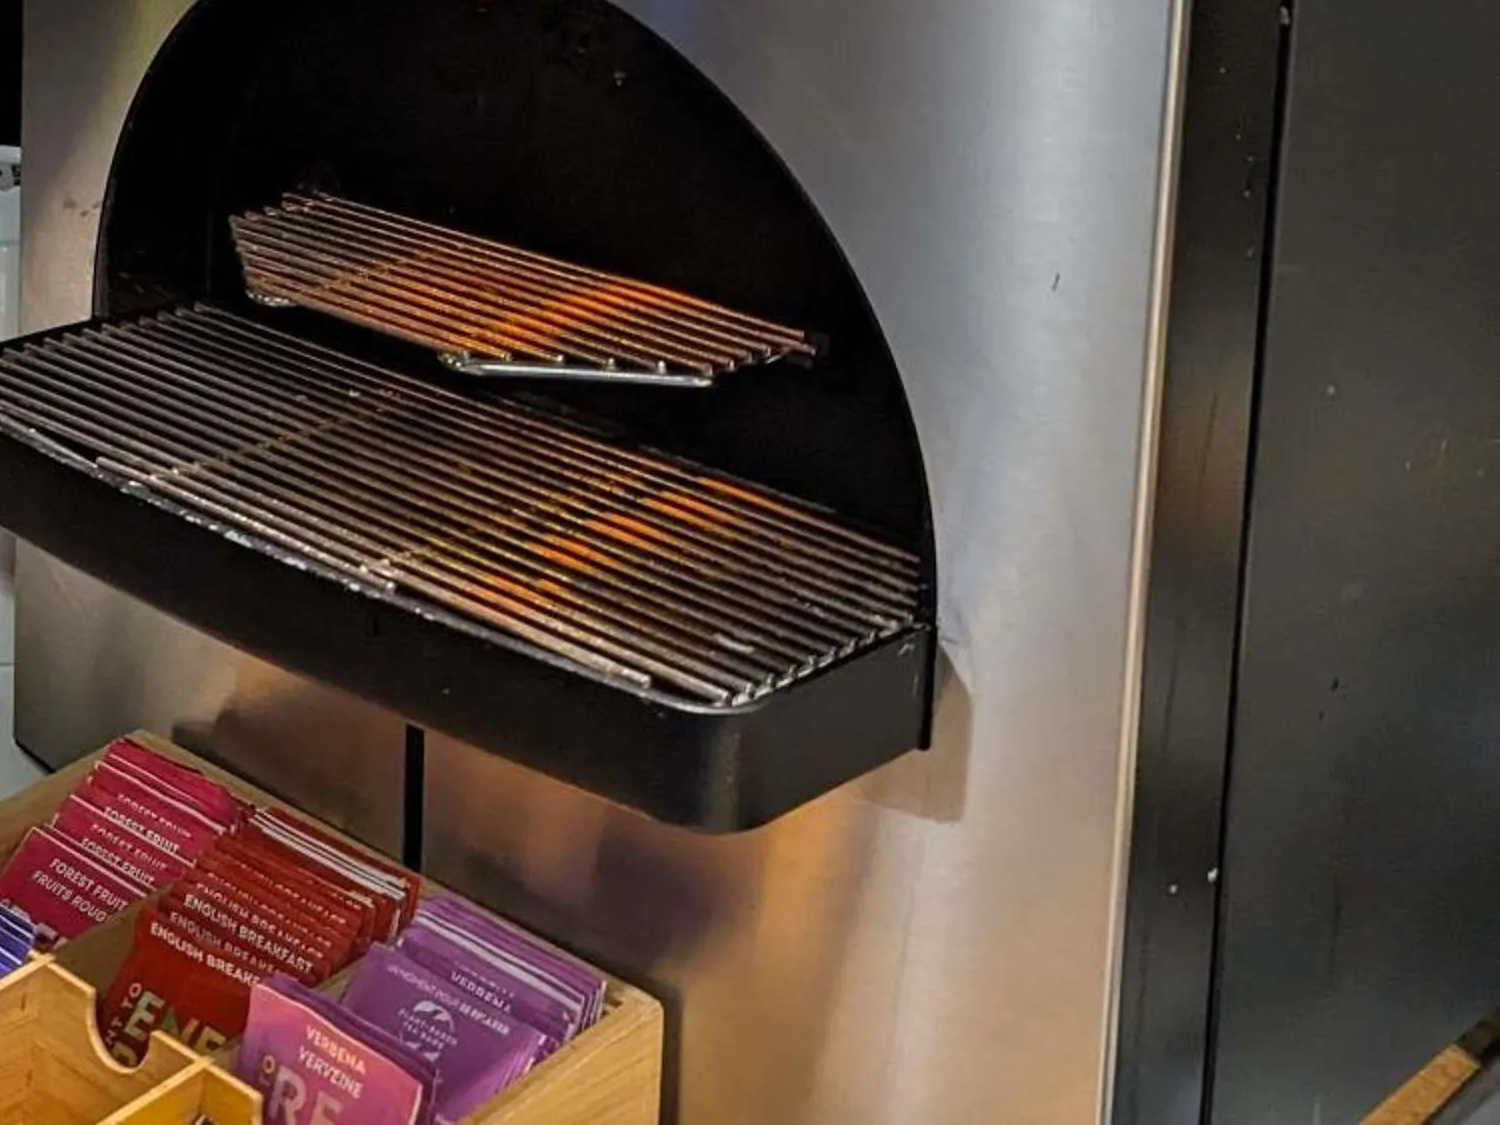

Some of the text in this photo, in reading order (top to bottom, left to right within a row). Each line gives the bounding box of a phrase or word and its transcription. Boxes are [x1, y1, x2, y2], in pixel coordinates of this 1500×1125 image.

[32, 869, 109, 923] FRUITS ROUG
[49, 858, 96, 892] FOREST
[150, 921, 261, 987] ENGLISH BREAKF
[183, 893, 239, 935] ENGLISH
[238, 924, 314, 974] BREAKFAST
[298, 1044, 364, 1100] VERVEINE
[305, 1024, 367, 1076] VERBENA
